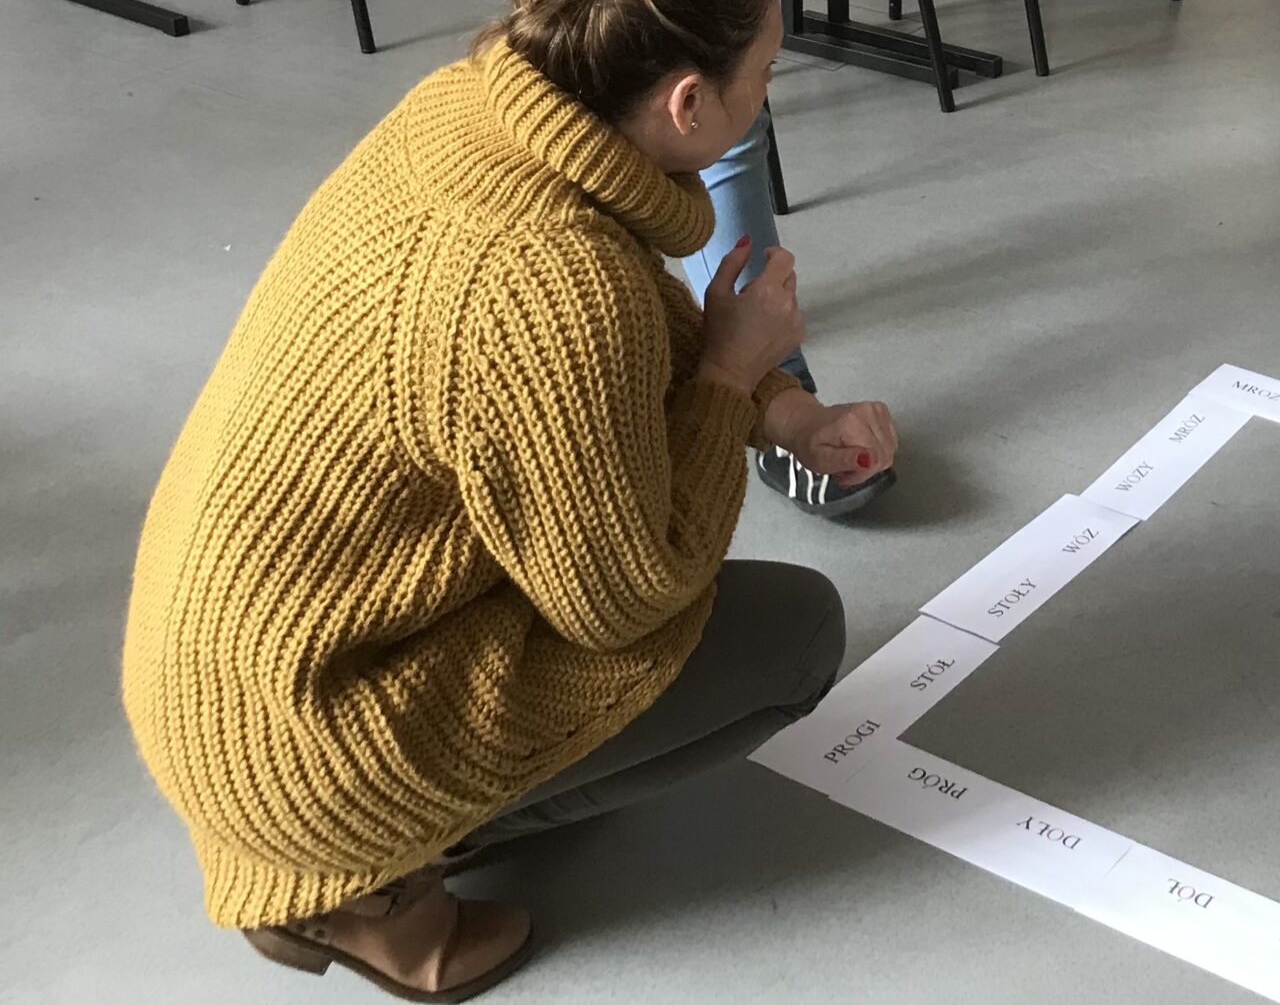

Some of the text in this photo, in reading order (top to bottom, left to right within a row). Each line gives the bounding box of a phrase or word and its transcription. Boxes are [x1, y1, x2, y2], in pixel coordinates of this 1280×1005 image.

[1115, 412, 1205, 494] WOZY MRÓZ
[988, 527, 1100, 618] STOŁY WÓZ
[824, 654, 956, 765] PROGI STÓŁ
[907, 766, 1082, 850] DOŁY PRÓG
[1167, 877, 1215, 910] DÓŁ
